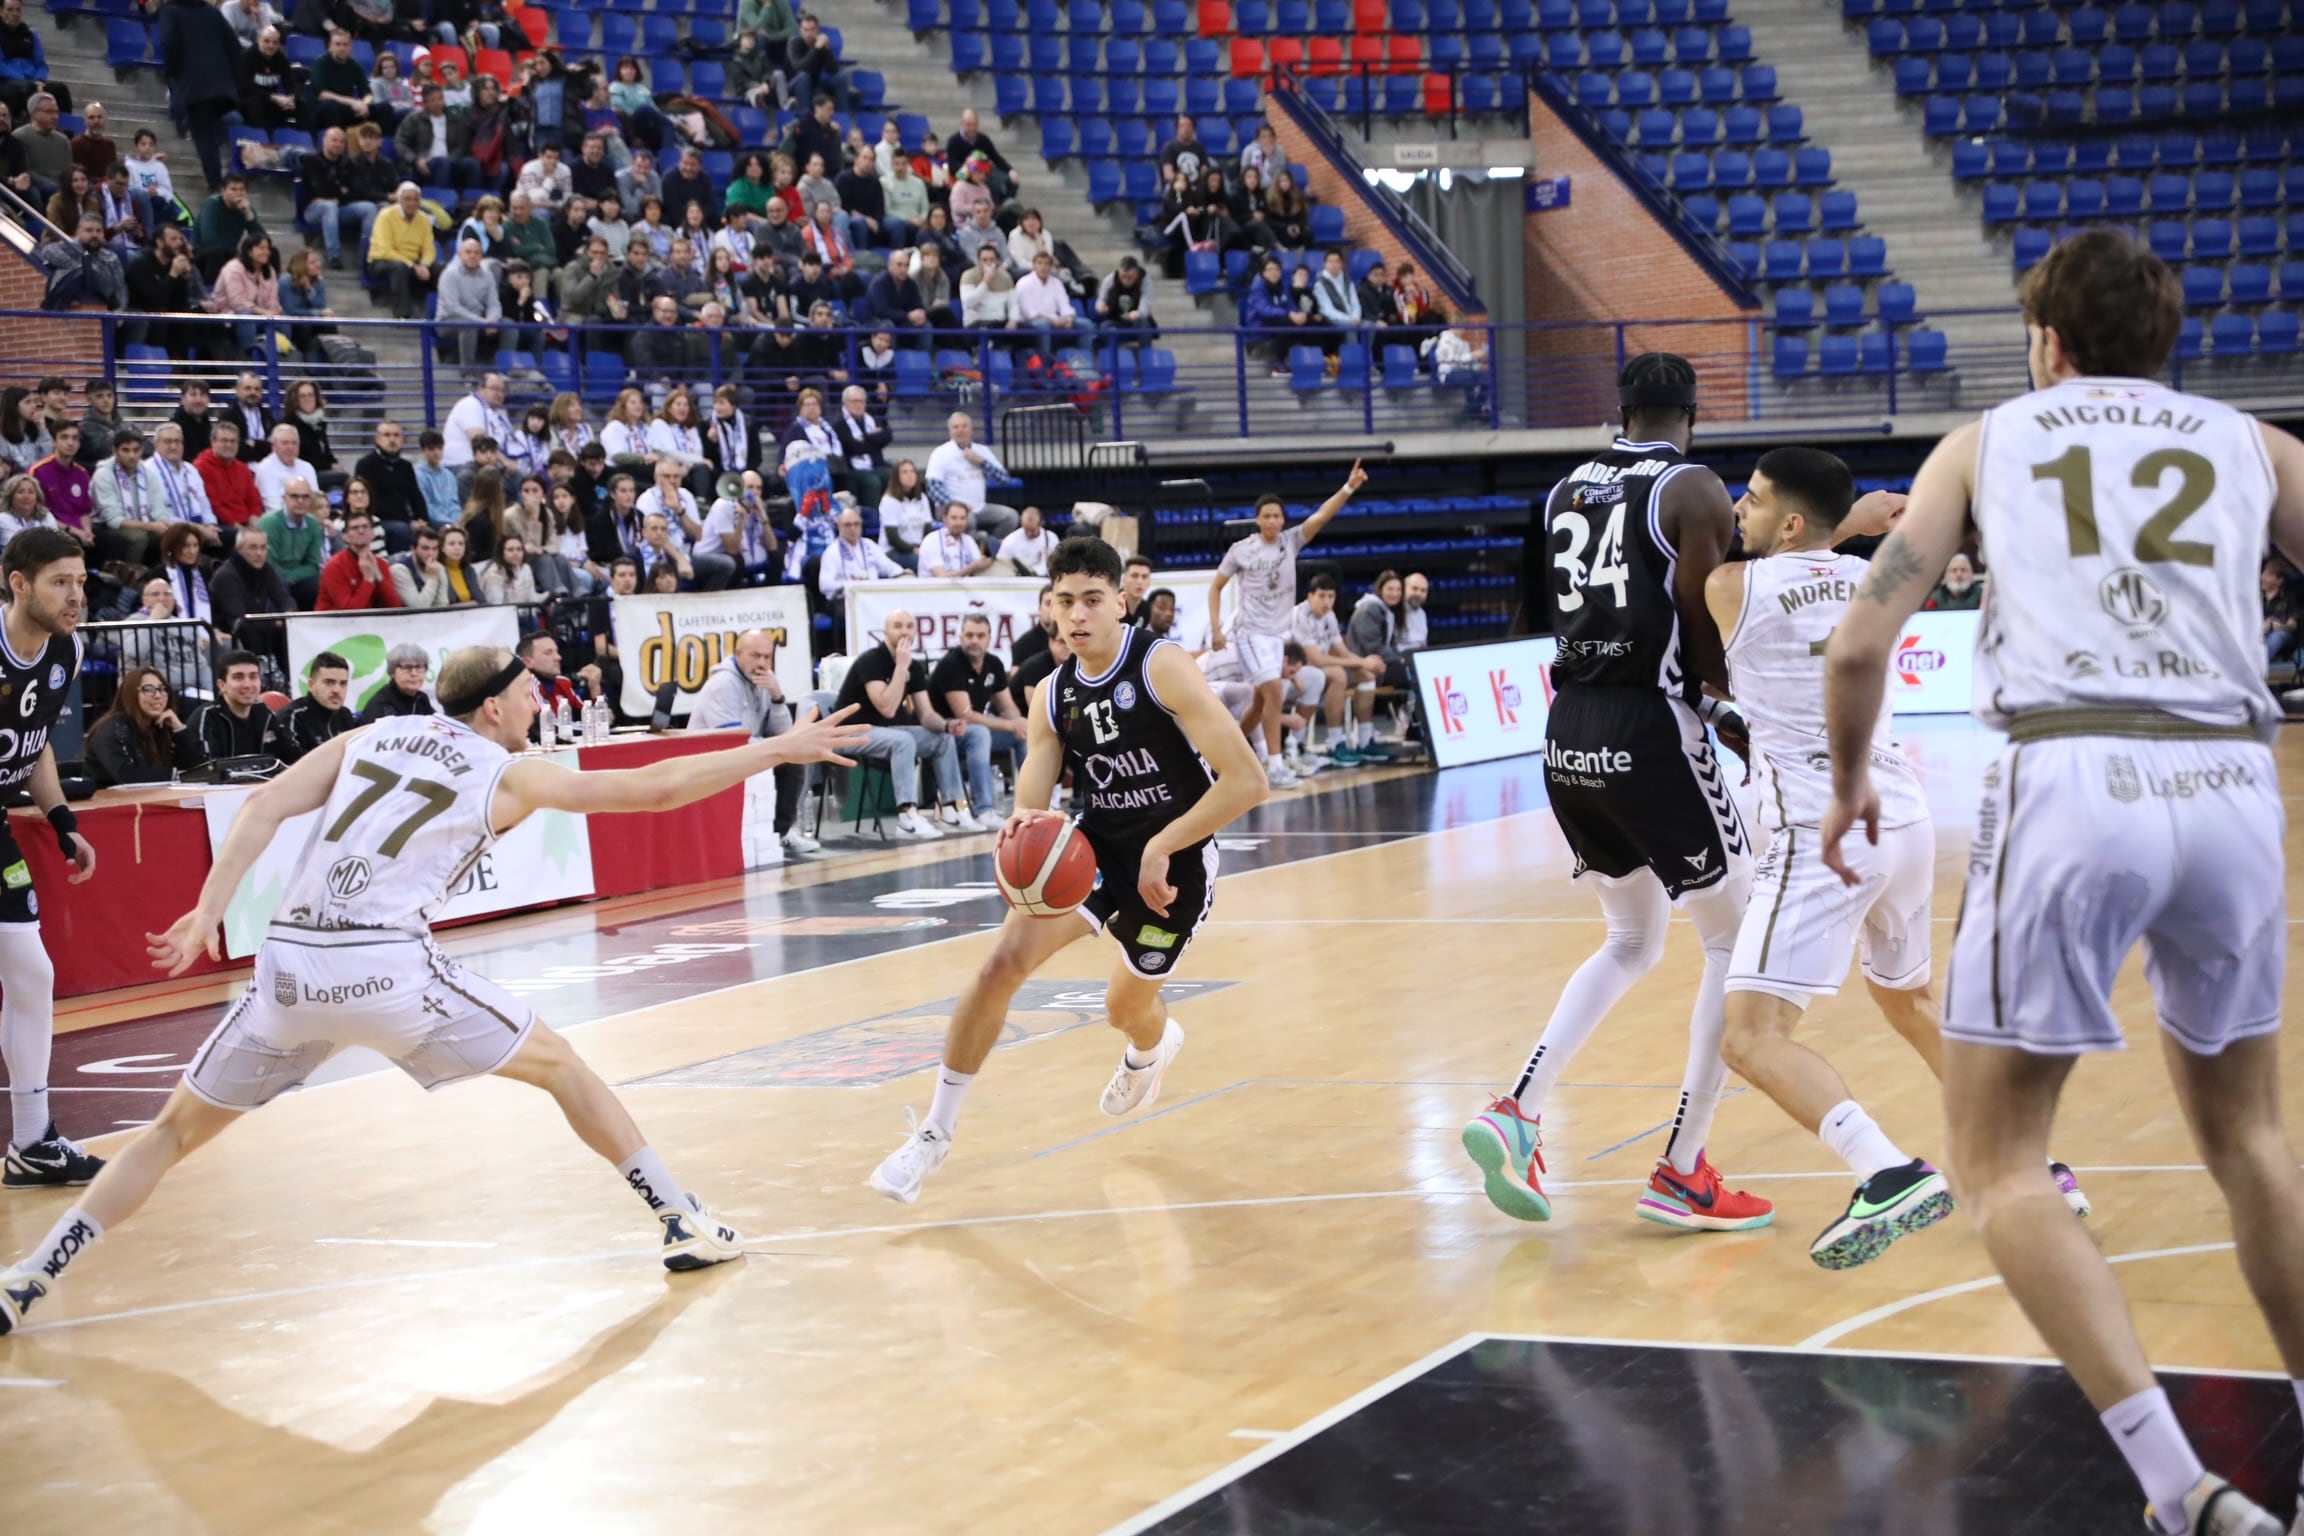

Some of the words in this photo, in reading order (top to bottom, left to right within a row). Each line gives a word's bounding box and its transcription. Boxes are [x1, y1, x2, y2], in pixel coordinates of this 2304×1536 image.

[2033, 405, 2206, 434] NICOLAU
[2030, 444, 2217, 569] 12
[1551, 501, 1630, 613] 34
[1777, 580, 1857, 615] MORE
[2113, 655, 2150, 678] La
[20, 678, 38, 717] 6
[1083, 698, 1120, 745] 13
[20, 724, 48, 758] HLA
[375, 735, 474, 778] KNUDSEN
[1541, 738, 1633, 774] Alicante
[1114, 747, 1160, 777] HLA
[1090, 783, 1173, 810] ALICANTE
[1551, 771, 1571, 787] City
[1571, 774, 1579, 786] &
[1579, 775, 1607, 789] Beach
[323, 758, 459, 860] 77
[331, 857, 367, 896] MG
[1681, 865, 1723, 886] CUPRA
[1141, 931, 1172, 945] CRC
[303, 976, 395, 1005] Logroño
